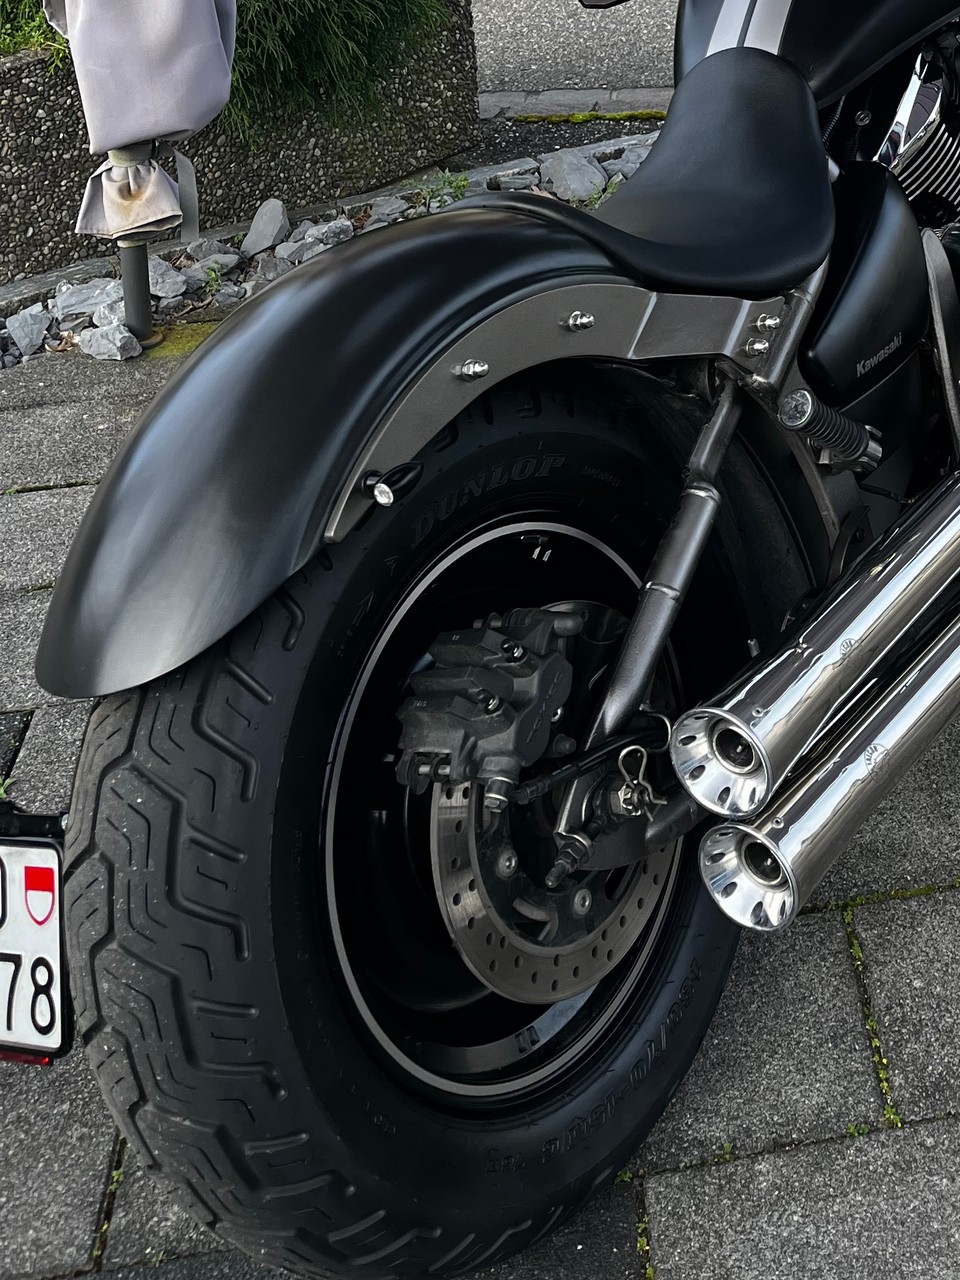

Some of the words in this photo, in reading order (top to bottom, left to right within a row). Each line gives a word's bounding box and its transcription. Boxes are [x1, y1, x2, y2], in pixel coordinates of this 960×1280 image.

[856, 331, 902, 378] Kawasaki
[410, 453, 567, 550] DUNLOP
[0, 952, 57, 1036] 78
